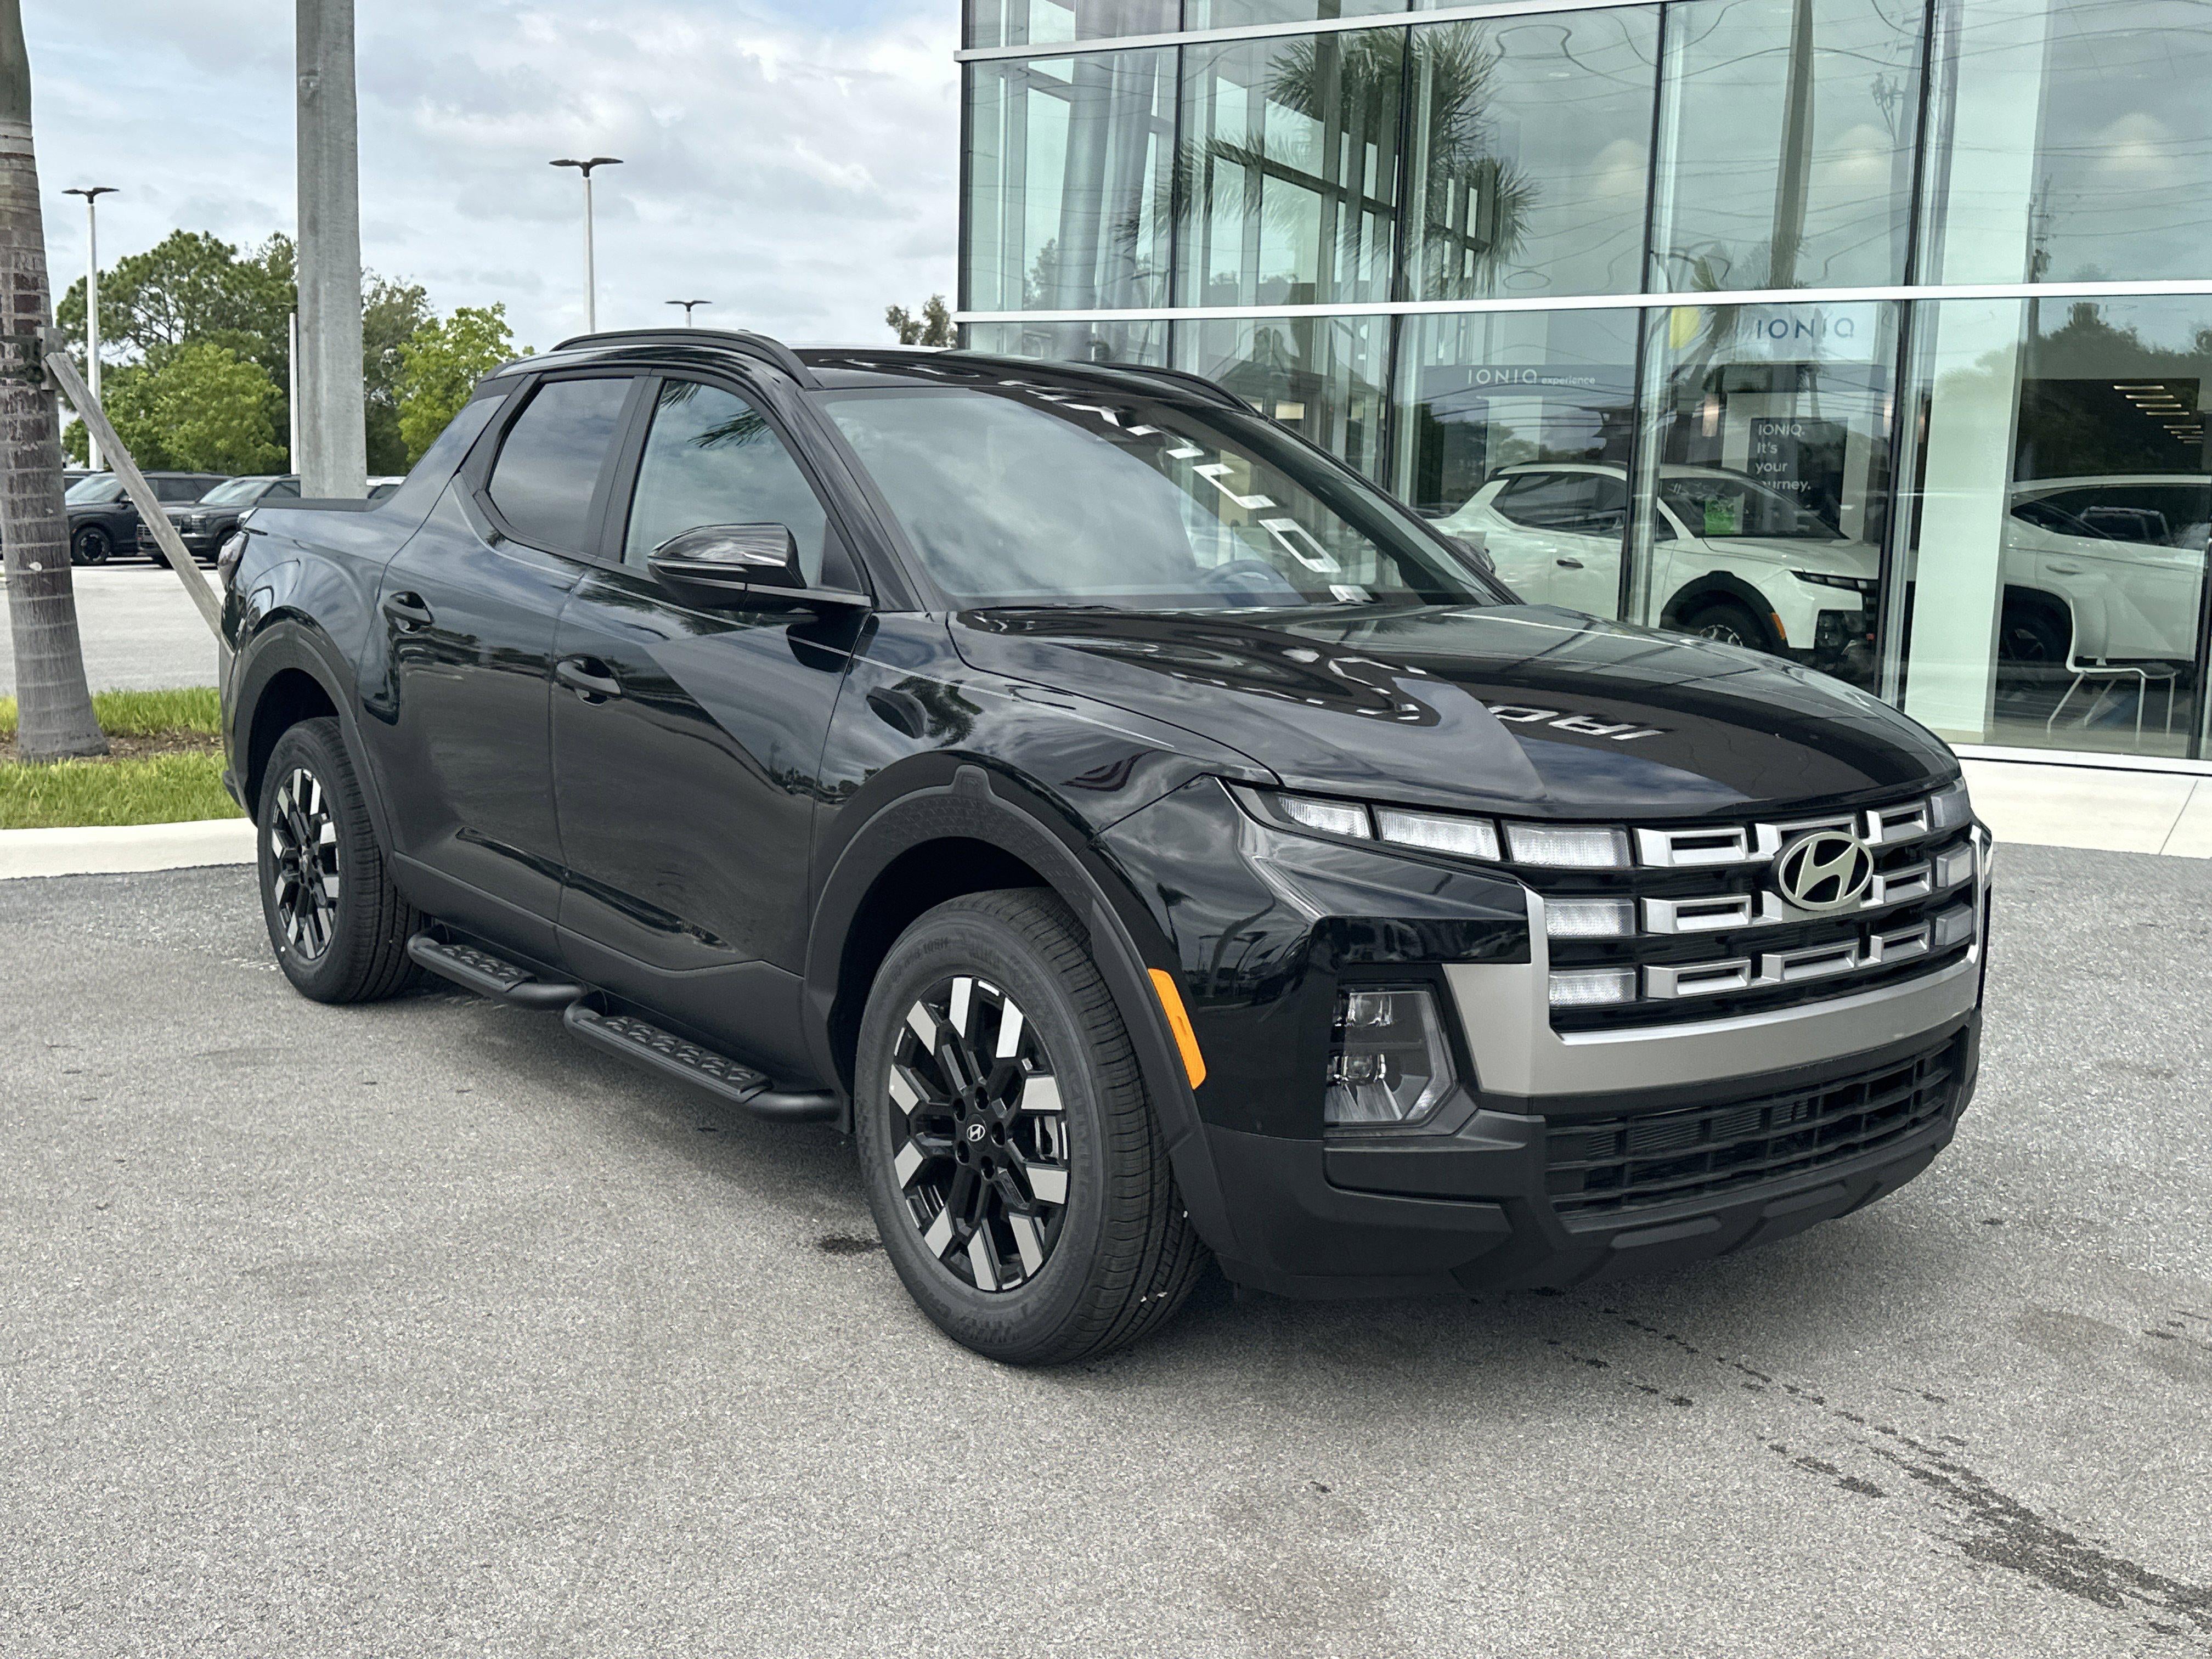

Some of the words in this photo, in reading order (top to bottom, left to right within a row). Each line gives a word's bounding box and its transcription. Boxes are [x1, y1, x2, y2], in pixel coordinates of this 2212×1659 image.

[1757, 317, 1855, 339] IONIQ
[1468, 369, 1537, 385] IONIQ
[1541, 375, 1596, 386] experience
[1758, 424, 1805, 437] IONIQ.
[1757, 441, 1778, 454] It's
[1755, 462, 1788, 475] your
